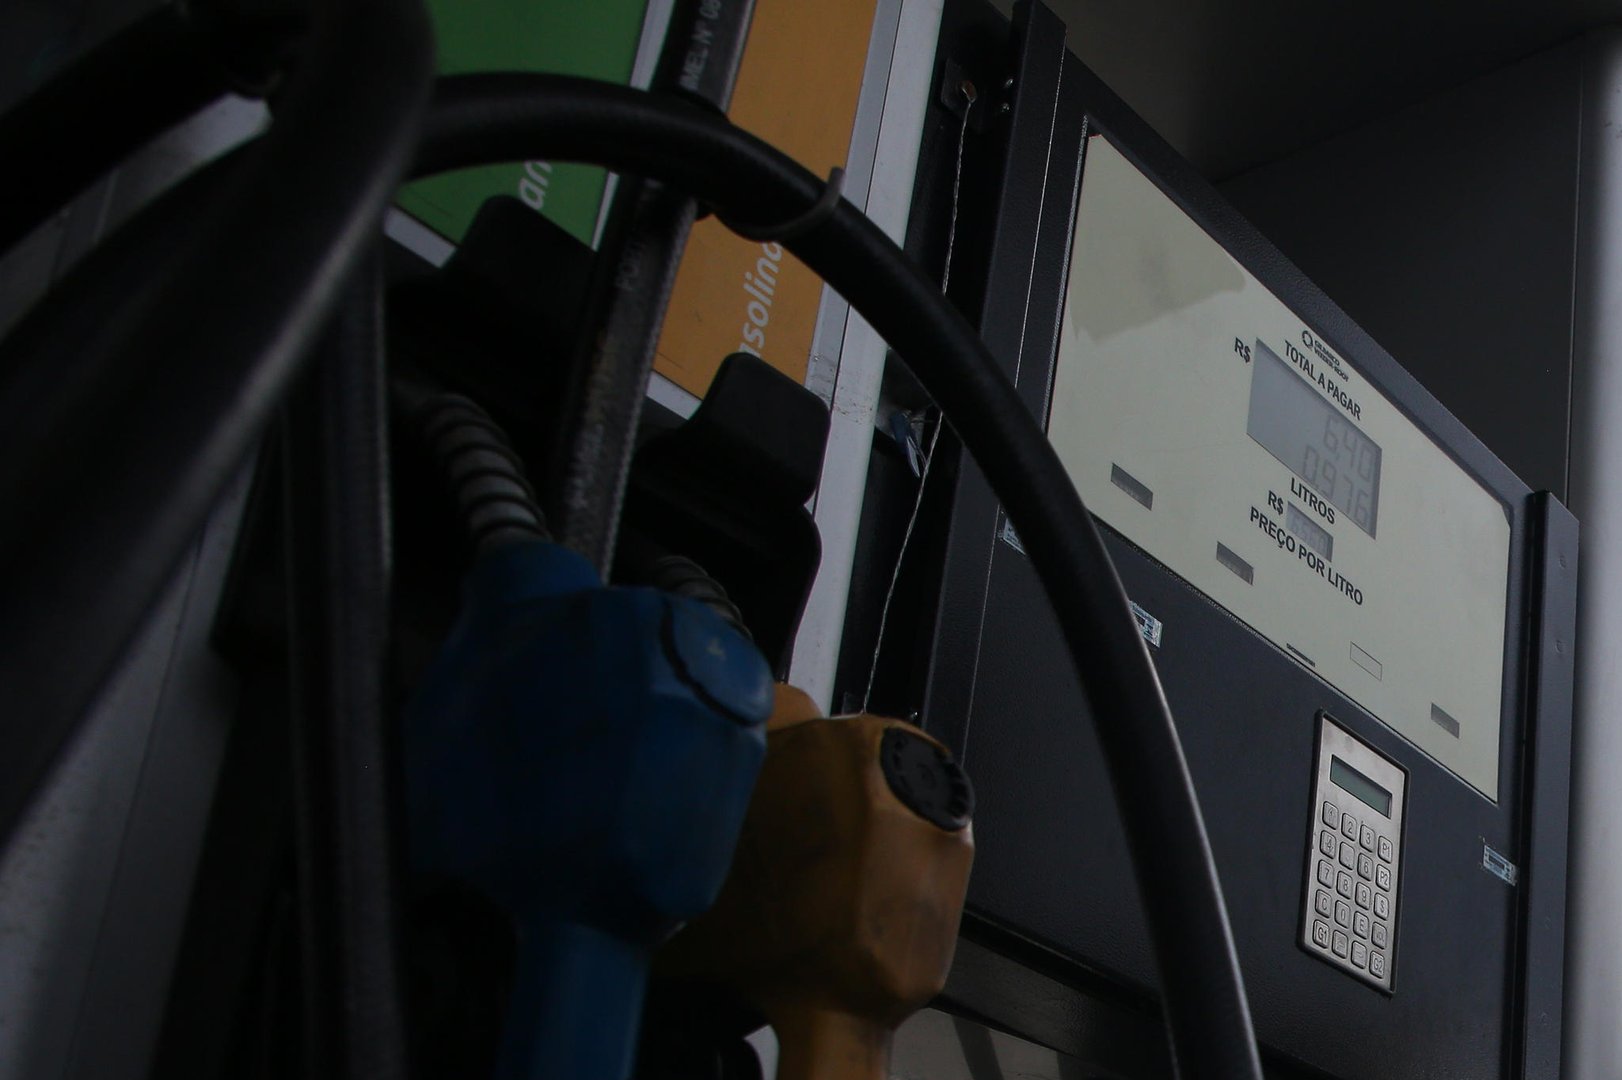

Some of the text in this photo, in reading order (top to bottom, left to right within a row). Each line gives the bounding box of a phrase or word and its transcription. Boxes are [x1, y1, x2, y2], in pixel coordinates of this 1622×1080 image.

[1234, 337, 1251, 363] R$
[1284, 340, 1362, 421] TOTAL A PAGAR
[1267, 489, 1284, 515] R$
[1290, 477, 1335, 525] LITROS
[1250, 506, 1296, 552] PREÇO
[1298, 543, 1325, 577] POR
[1327, 566, 1363, 606] LITRO
